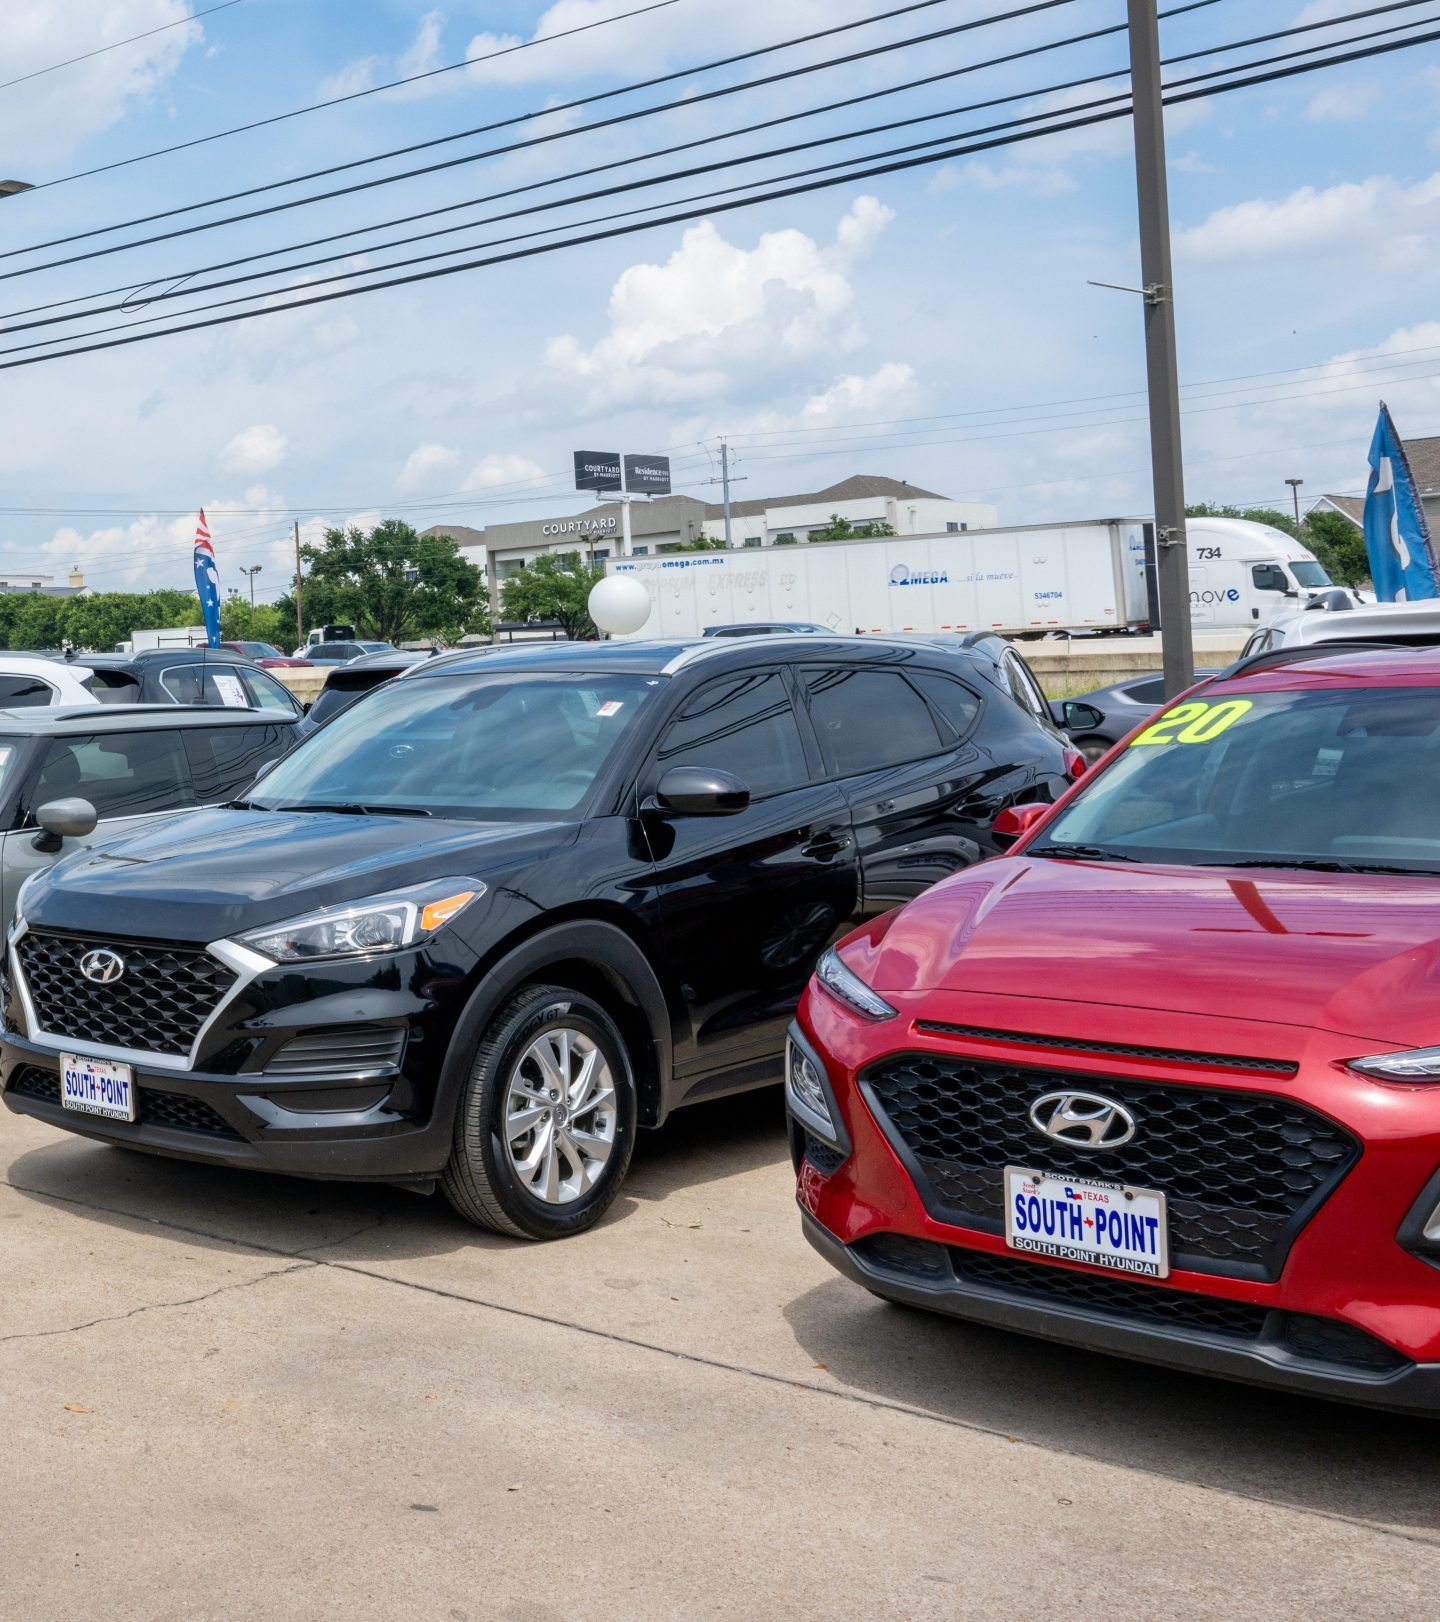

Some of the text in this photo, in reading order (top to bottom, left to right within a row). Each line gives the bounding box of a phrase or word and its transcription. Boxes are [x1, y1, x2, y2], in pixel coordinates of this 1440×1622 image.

[584, 465, 620, 474] COURTYARD
[634, 467, 662, 476] Residence
[542, 517, 616, 535] COURTYARD
[1196, 547, 1222, 559] 734
[1129, 699, 1253, 747] 20
[65, 1070, 129, 1107] SOUTH POINT
[65, 1100, 129, 1120] SOUTH POINT HYUNDAI
[1044, 1172, 1121, 1190] SCOTT STARK'S
[1082, 1190, 1110, 1203] TEXAS
[1015, 1193, 1158, 1255] SOUTH POINT
[1015, 1237, 1157, 1275] SOUTH POINT HYUNDAI
